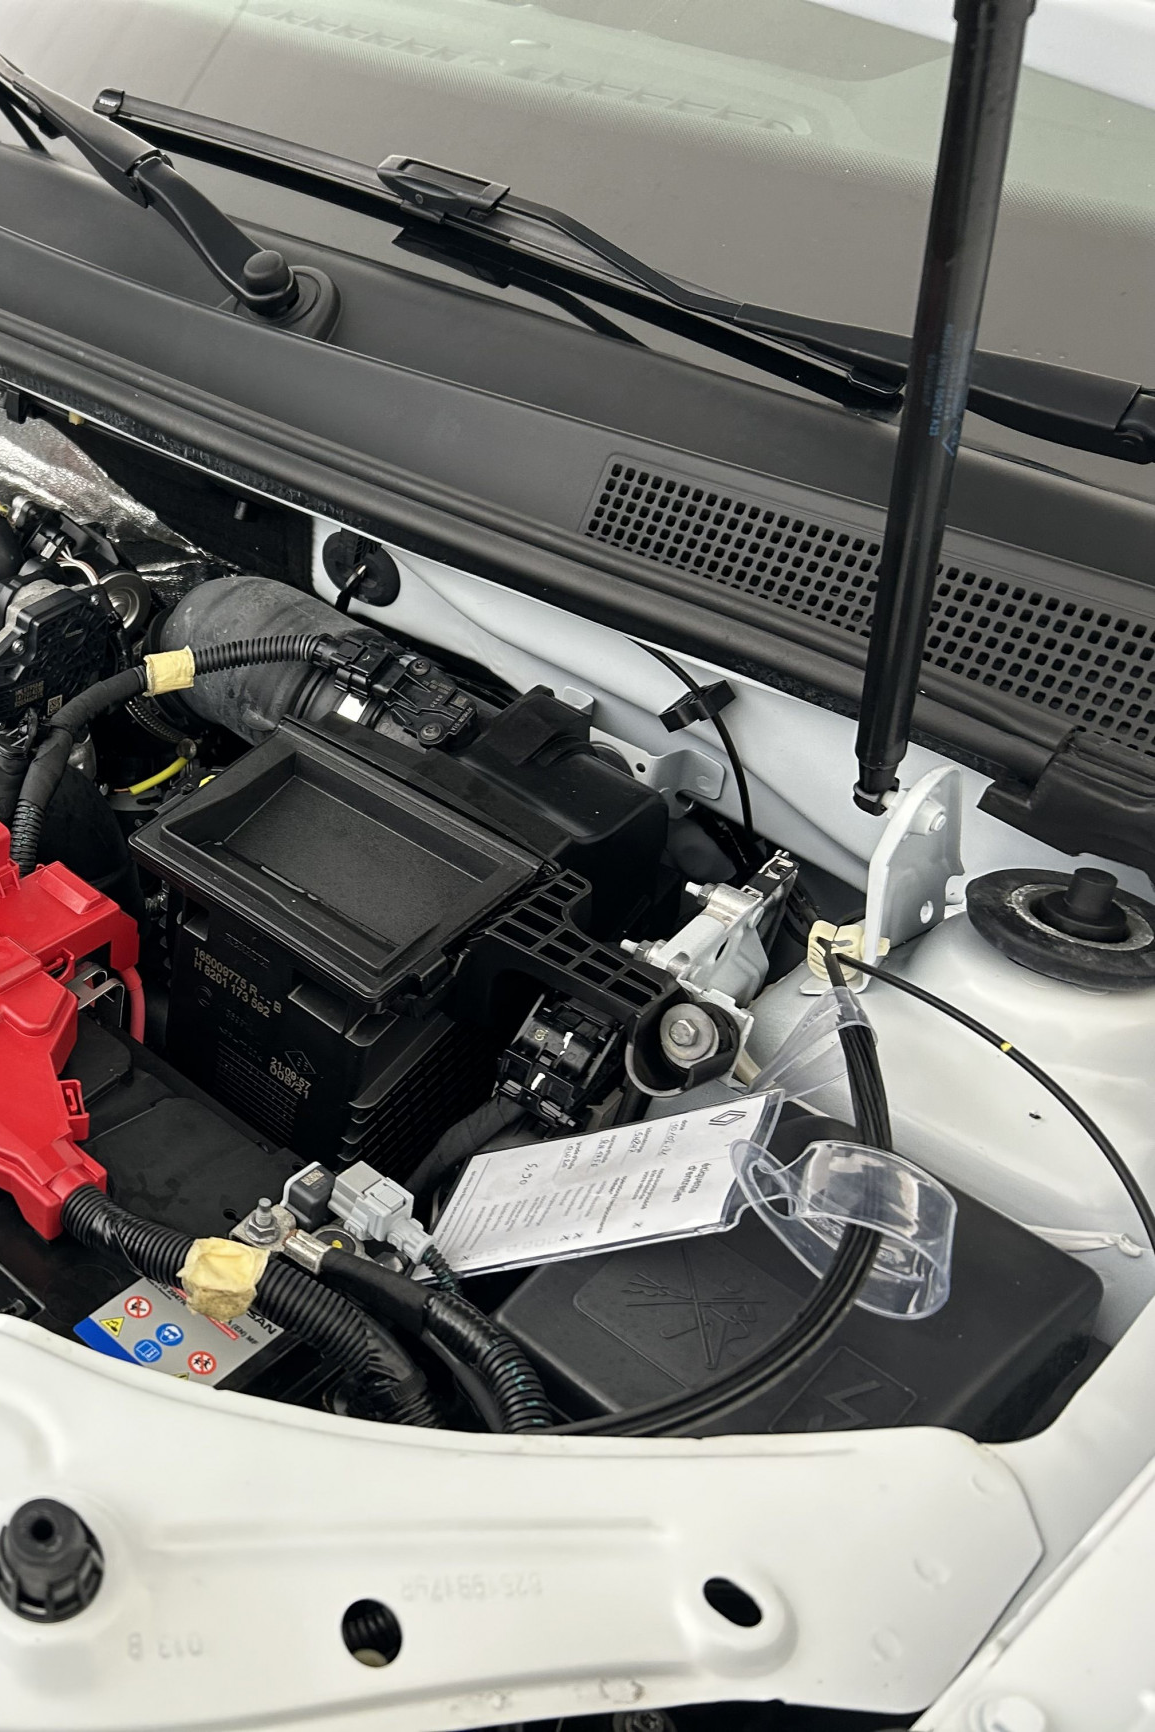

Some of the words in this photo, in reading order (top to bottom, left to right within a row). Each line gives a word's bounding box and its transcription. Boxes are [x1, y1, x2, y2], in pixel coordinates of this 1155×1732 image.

[193, 957, 203, 971] H
[204, 965, 228, 988] 8201
[231, 984, 248, 1002] 173
[671, 1164, 698, 1203] d'entretien
[231, 1323, 248, 1338] (EN)
[246, 1310, 277, 1334] SAN
